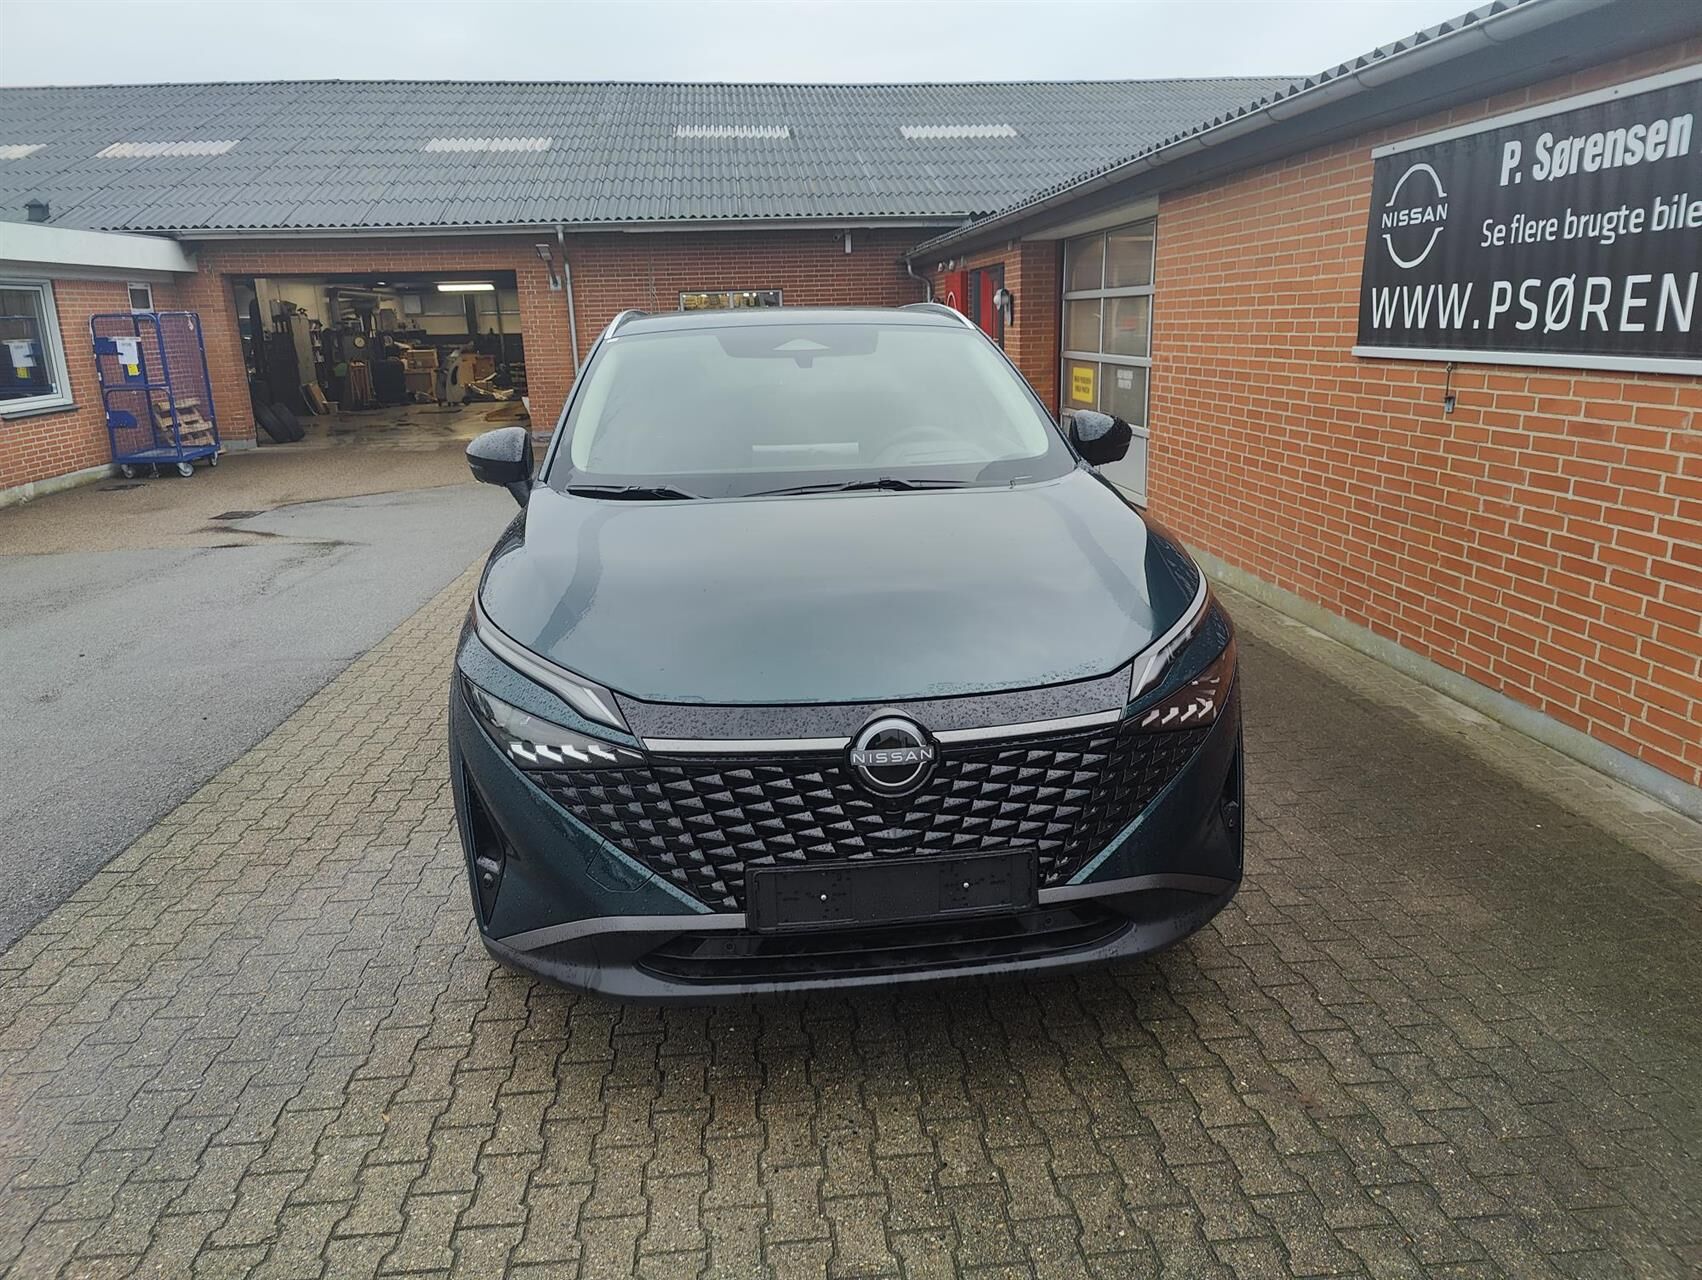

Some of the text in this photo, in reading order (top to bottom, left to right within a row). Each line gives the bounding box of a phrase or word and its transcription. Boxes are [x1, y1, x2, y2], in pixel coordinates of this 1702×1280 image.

[1499, 112, 1694, 187] P. Sørensen
[1381, 203, 1449, 229] NISSAN
[1480, 218, 1505, 248] Se
[1510, 213, 1557, 245] flere
[1563, 204, 1645, 246] brugte
[1371, 272, 1699, 334] WWW.PSØREN
[852, 748, 933, 764] NISSAN
